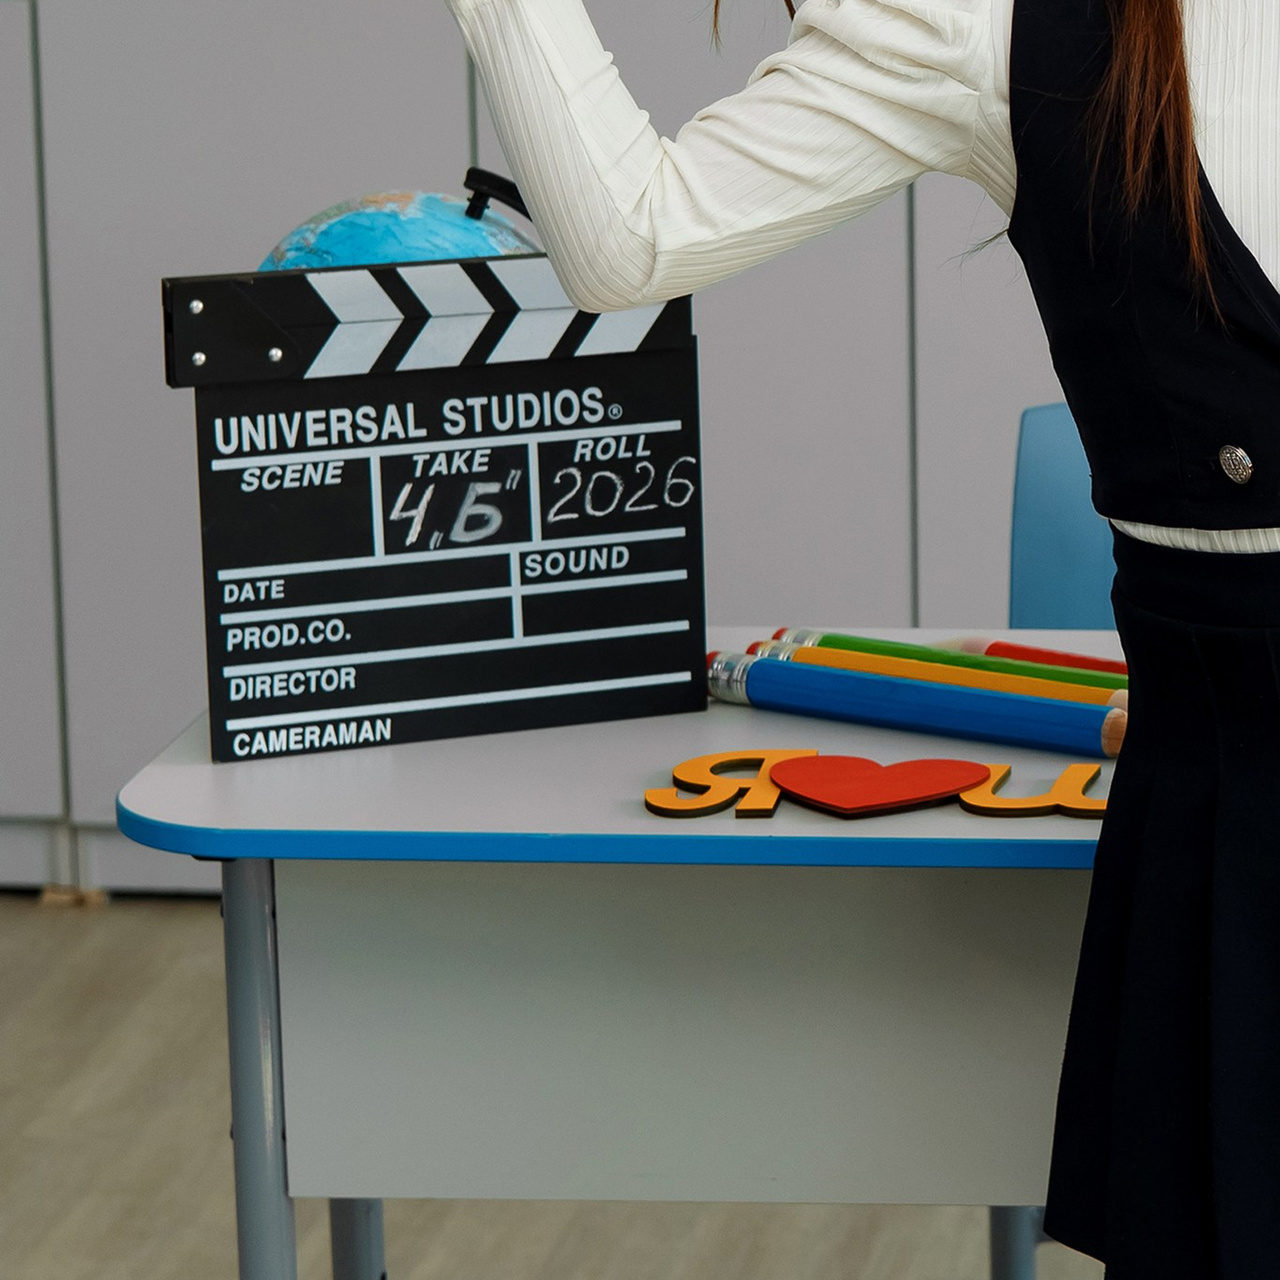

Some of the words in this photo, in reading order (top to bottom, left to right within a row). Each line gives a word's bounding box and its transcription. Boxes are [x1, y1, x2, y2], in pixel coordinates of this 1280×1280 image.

[213, 402, 428, 455] UNIVERSAL
[412, 449, 492, 478] TAKE
[573, 434, 652, 463] ROLL
[240, 460, 345, 493] SCENE
[547, 456, 697, 523] 2026
[524, 546, 630, 578] SOUND
[223, 580, 286, 604] DATE
[226, 621, 352, 652] PROD.CO.
[229, 667, 357, 701] DIRECTOR
[233, 719, 392, 757] CAMERAMAN
[645, 749, 819, 819] Я
